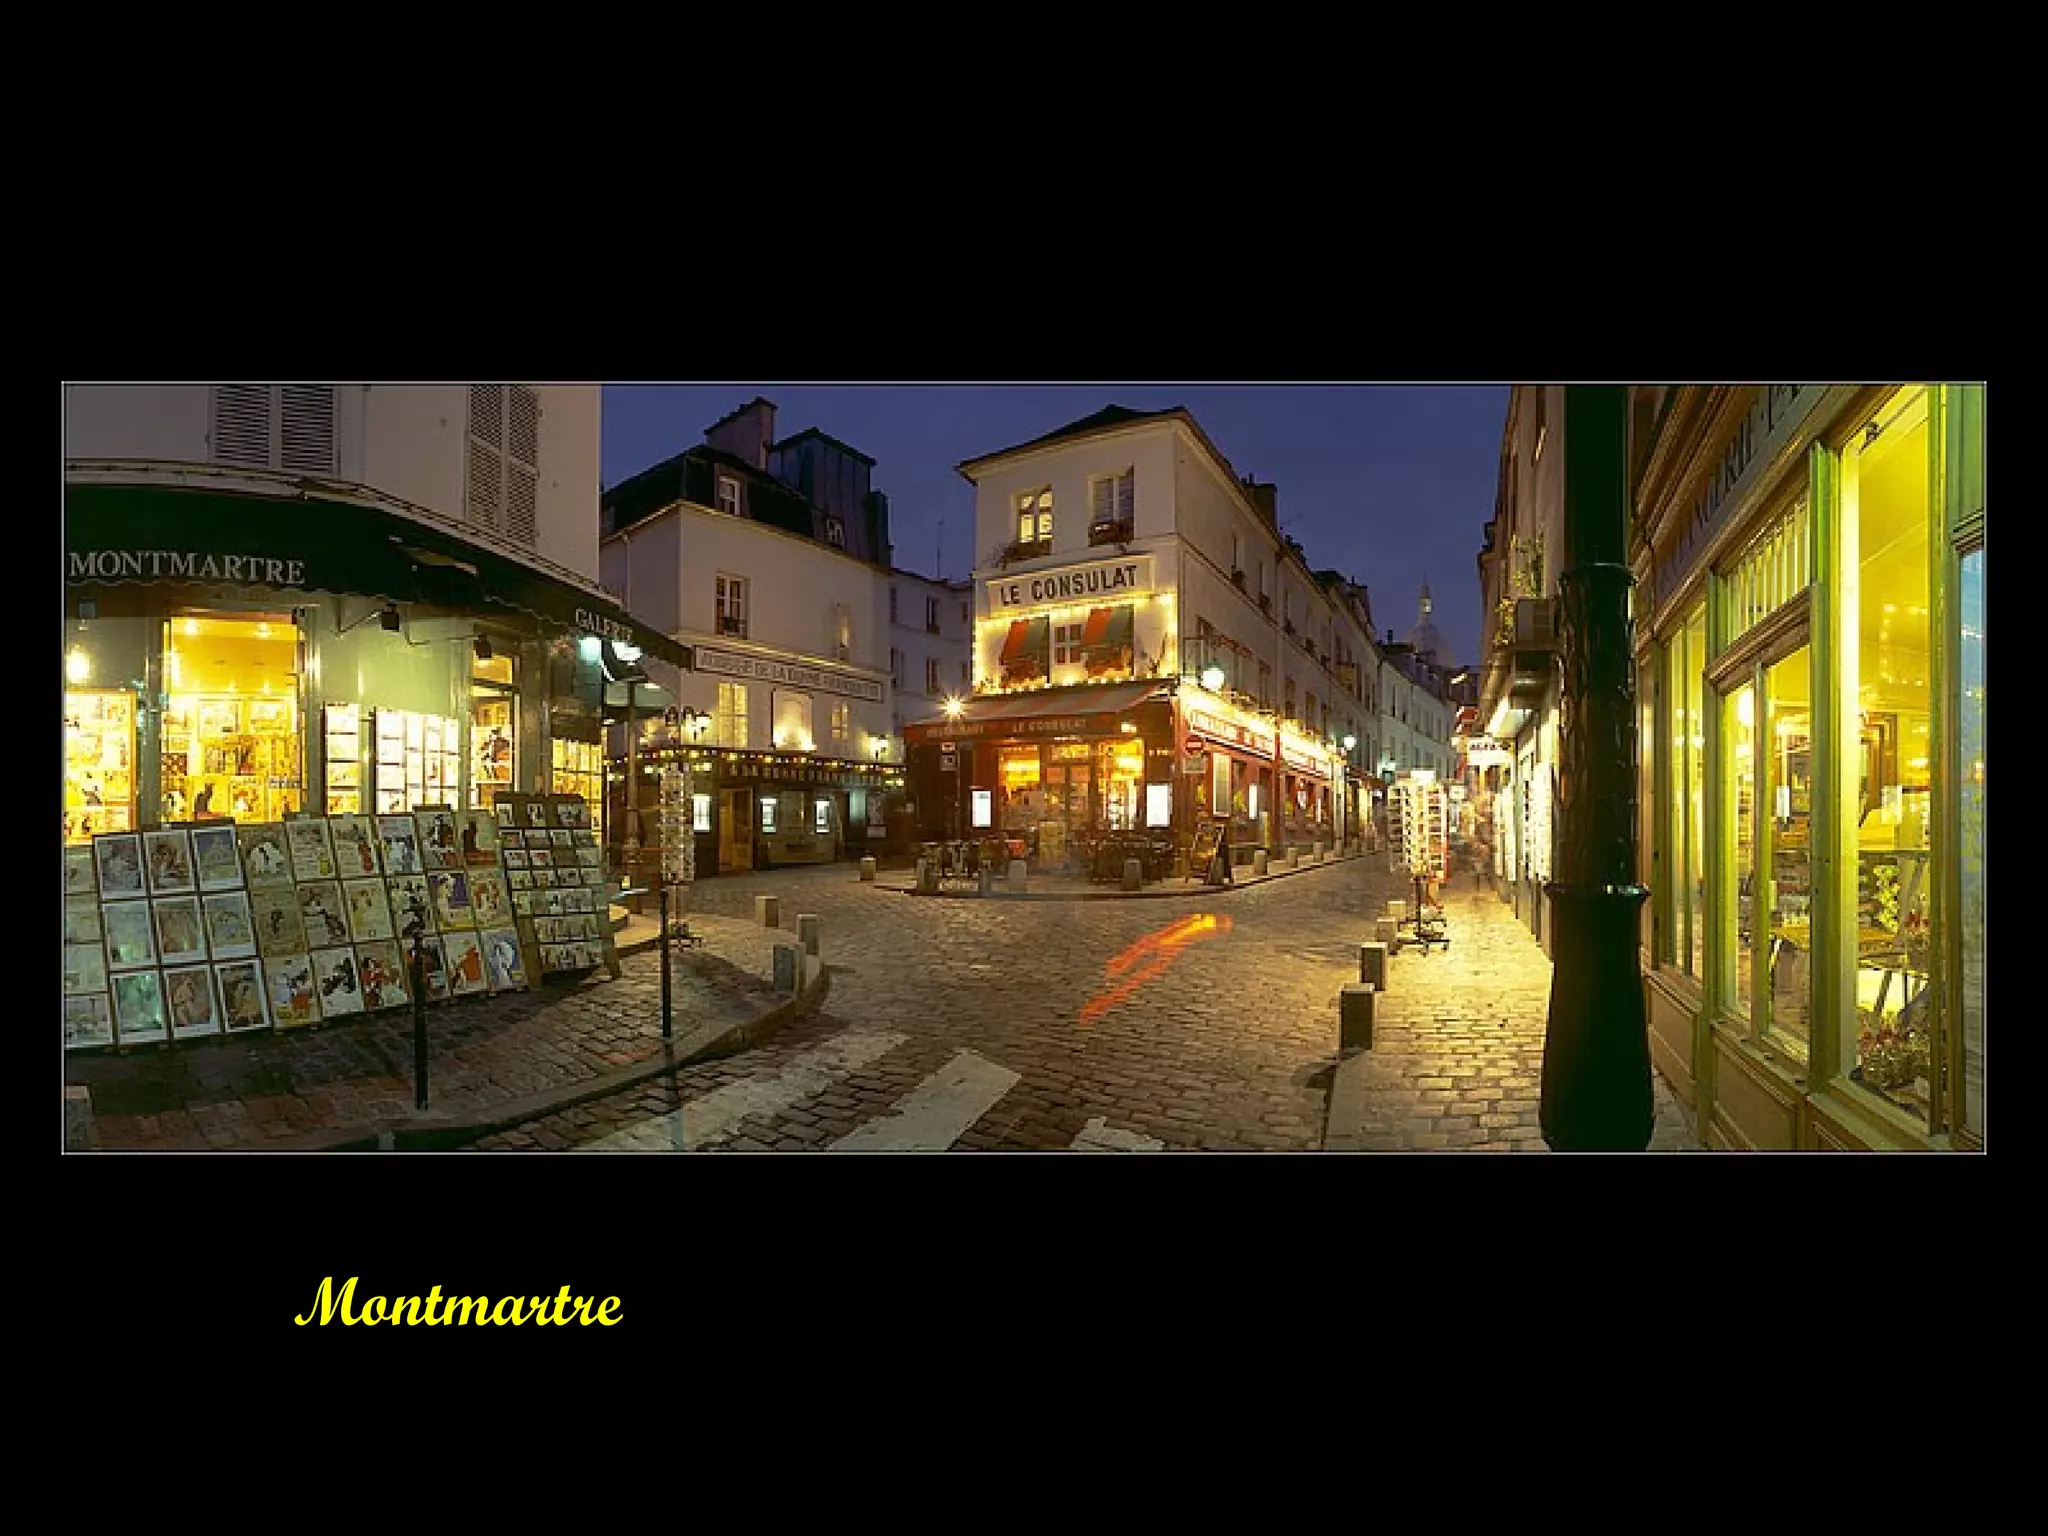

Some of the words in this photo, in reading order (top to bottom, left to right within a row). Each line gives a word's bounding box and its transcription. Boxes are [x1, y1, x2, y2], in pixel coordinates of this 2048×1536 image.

[69, 550, 306, 584] MONTMARTRE
[1001, 585, 1020, 606] LE
[1031, 565, 1137, 600] CONSULAT
